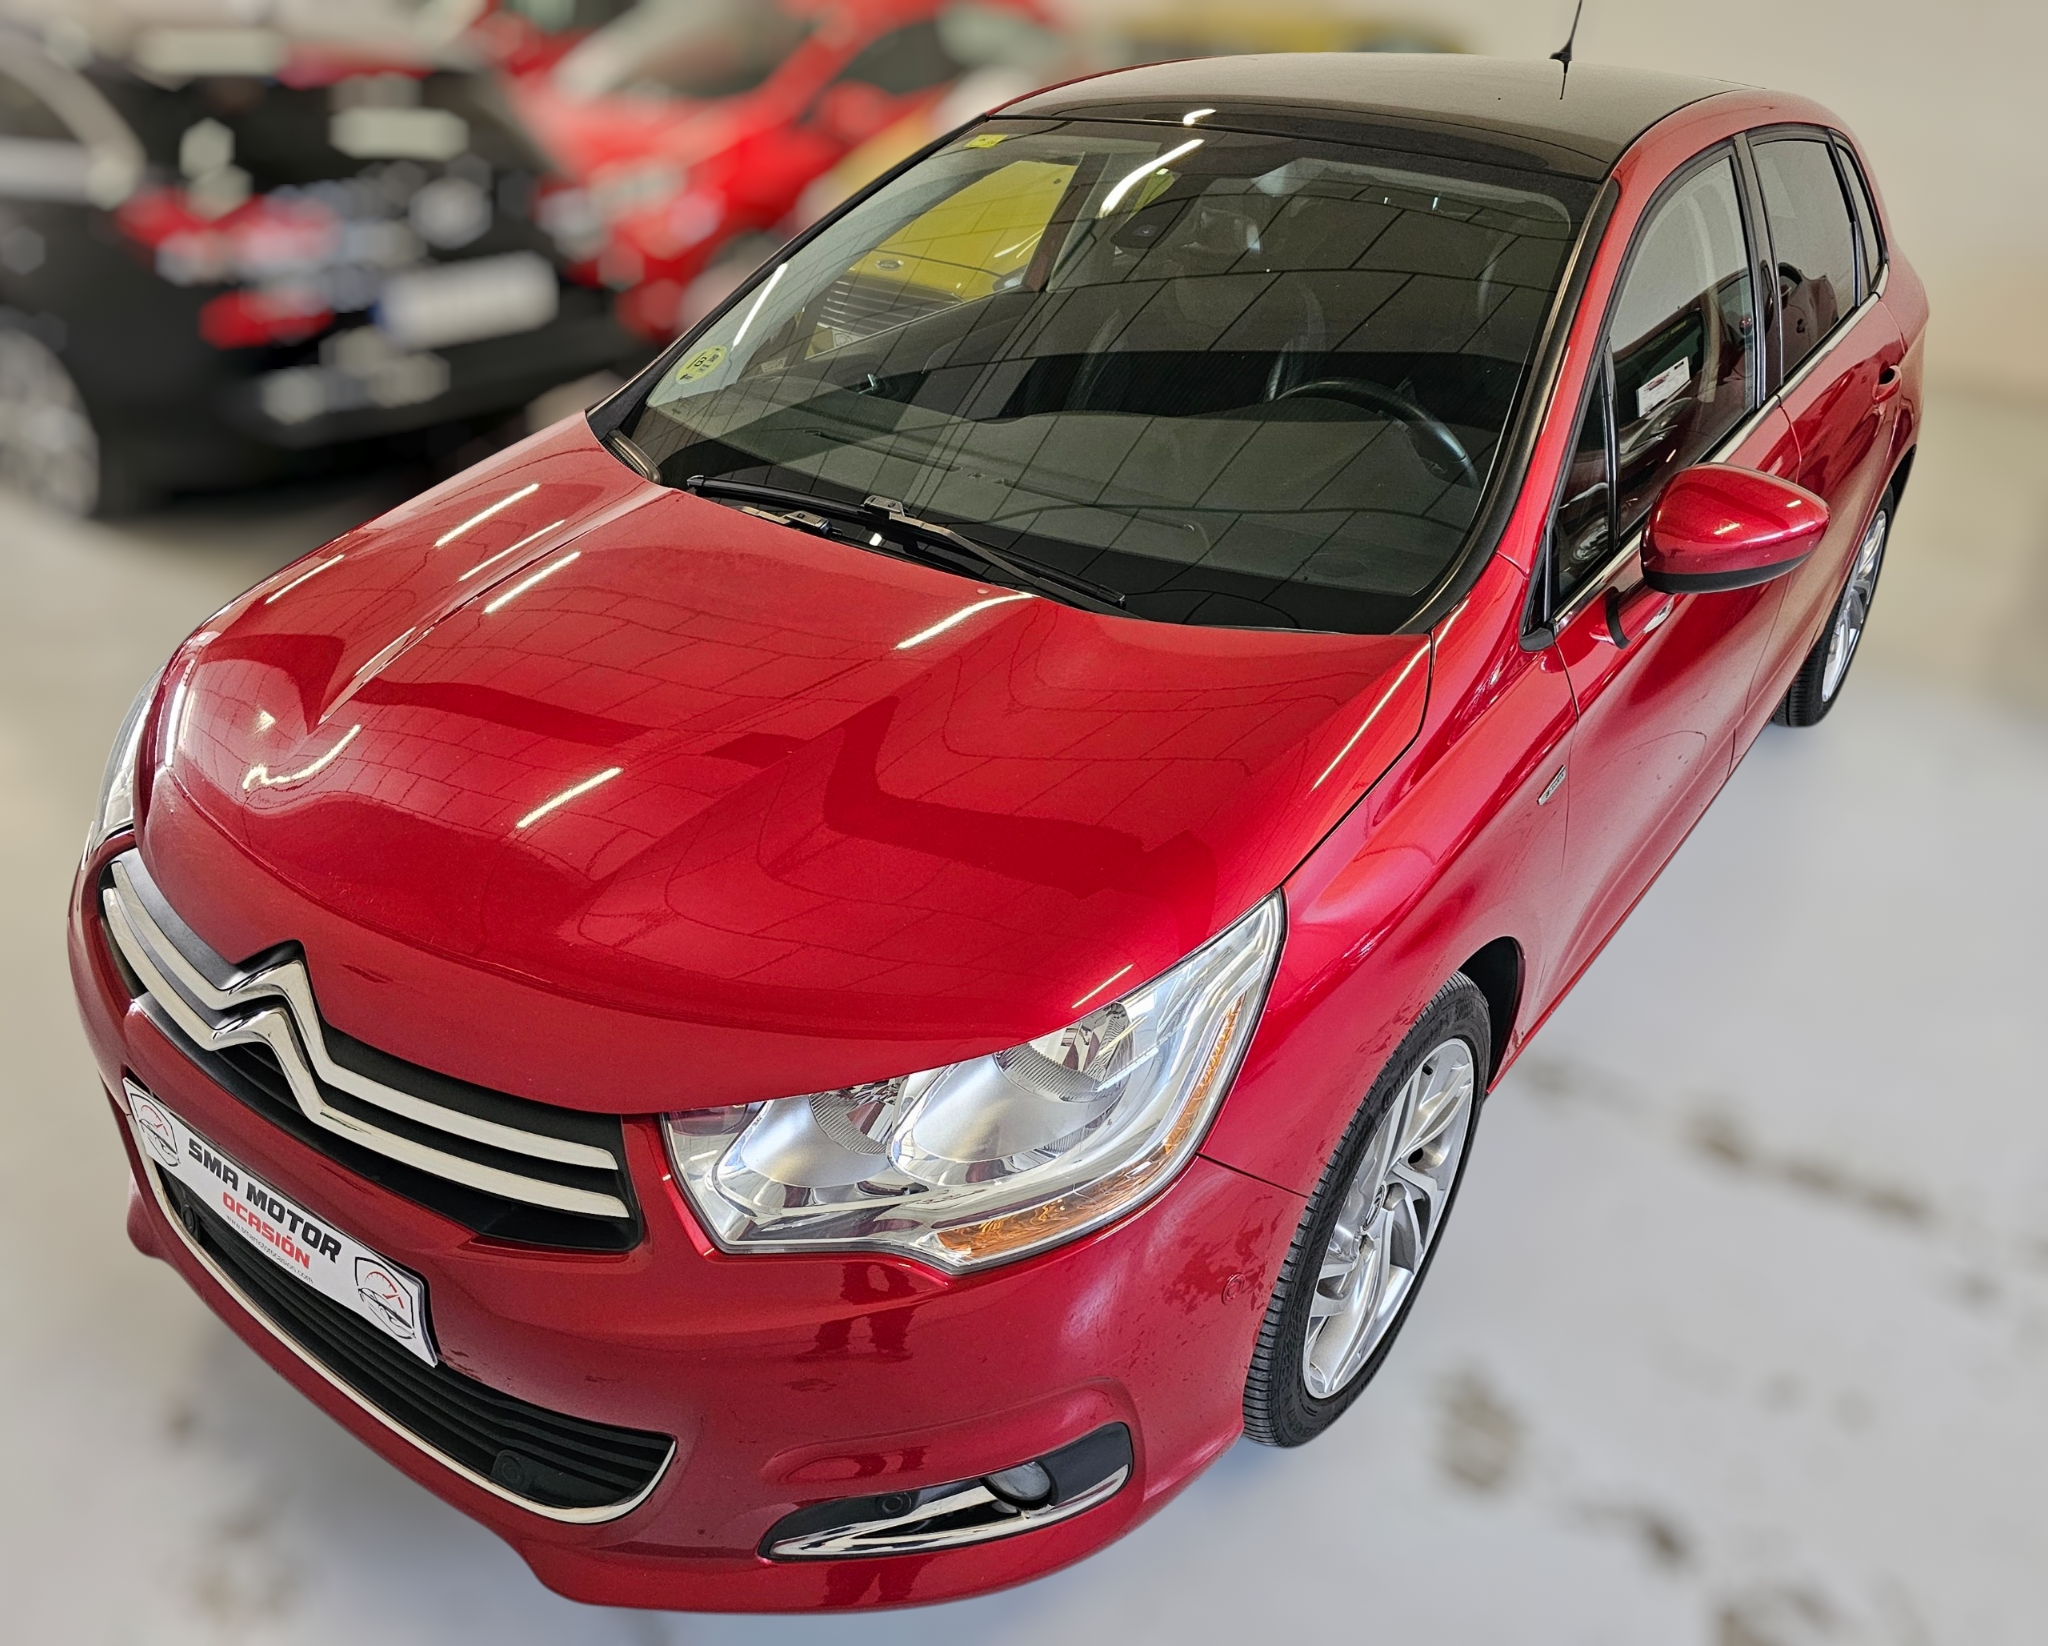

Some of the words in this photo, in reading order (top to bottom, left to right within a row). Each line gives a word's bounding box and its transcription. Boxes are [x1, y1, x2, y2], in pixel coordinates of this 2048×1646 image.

[189, 1138, 239, 1192] SMA
[246, 1181, 342, 1264] MOTOR
[222, 1191, 310, 1270] OCASIÓN
